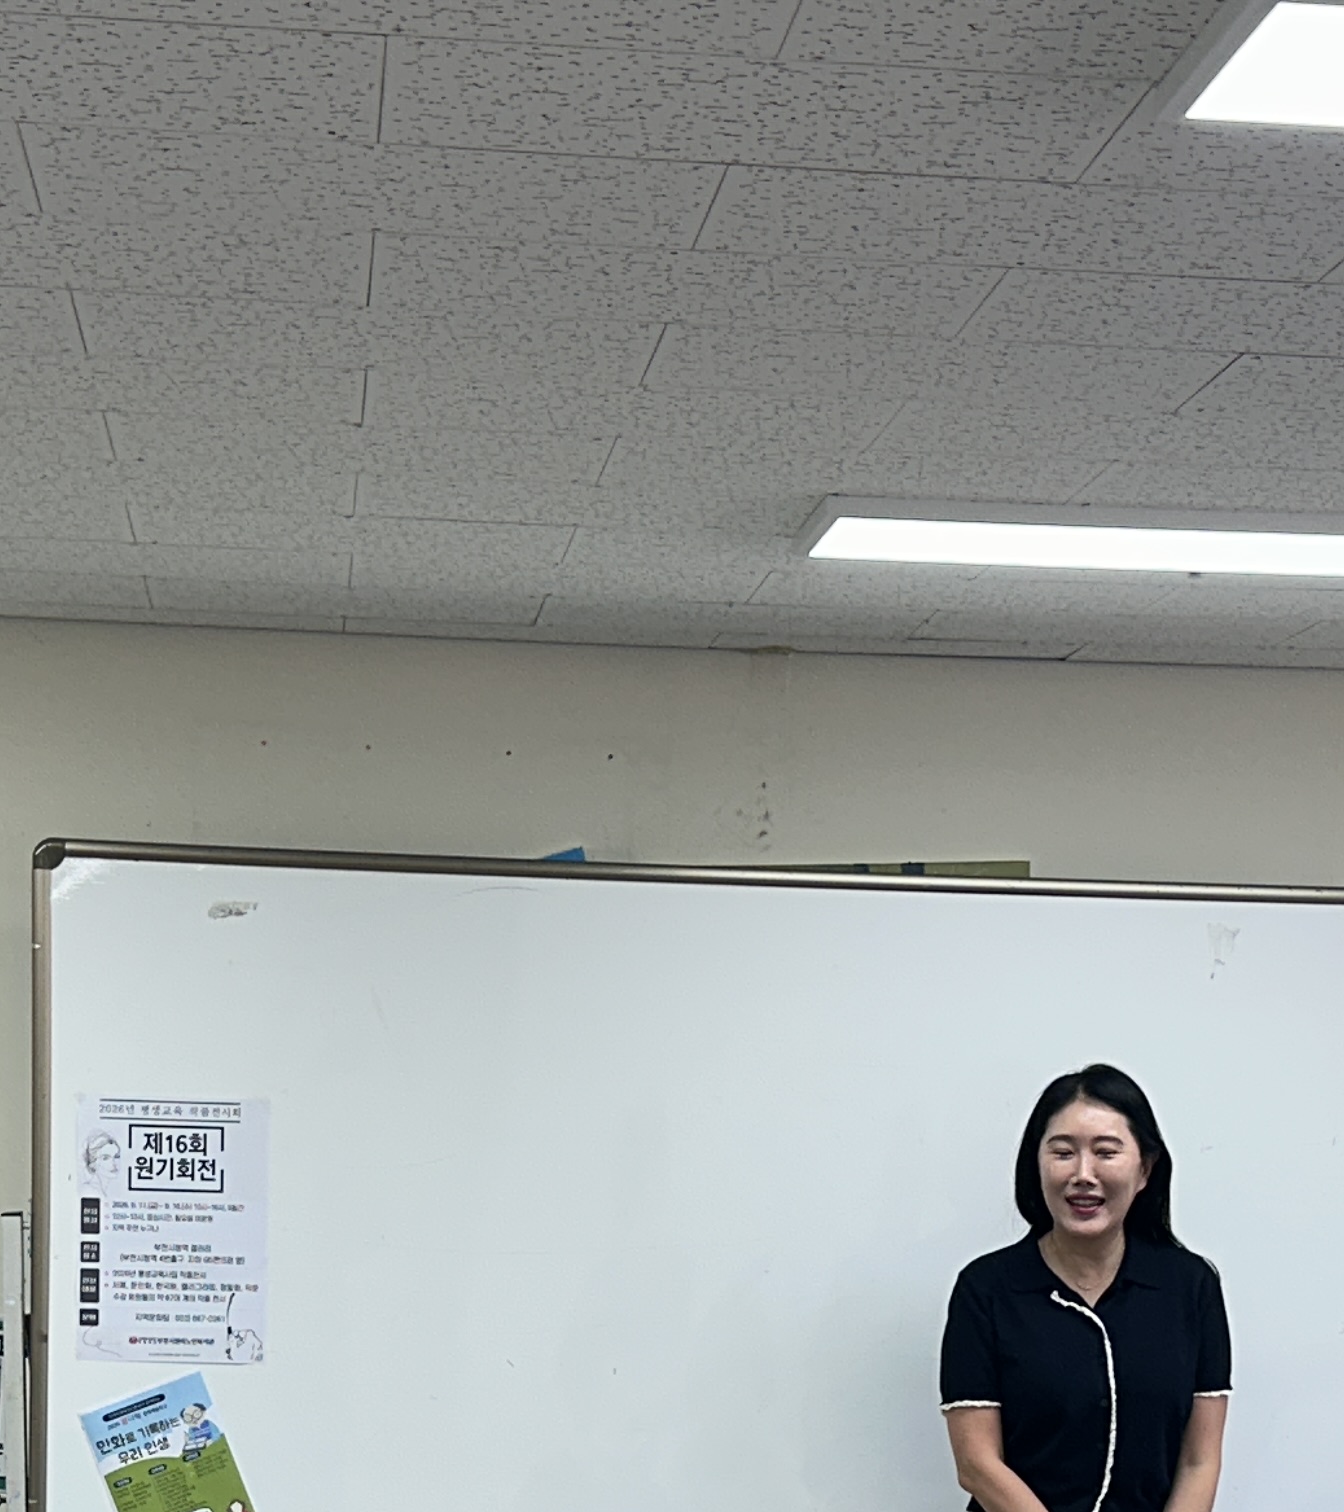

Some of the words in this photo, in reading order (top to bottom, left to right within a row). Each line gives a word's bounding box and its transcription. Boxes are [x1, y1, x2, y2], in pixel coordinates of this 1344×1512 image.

[143, 1132, 207, 1156] 제16회
[134, 1157, 217, 1181] 원기회전
[96, 1432, 137, 1455] 만화로
[137, 1417, 181, 1438] 기록하는
[118, 1446, 143, 1464] 우리
[144, 1437, 170, 1456] 인생
